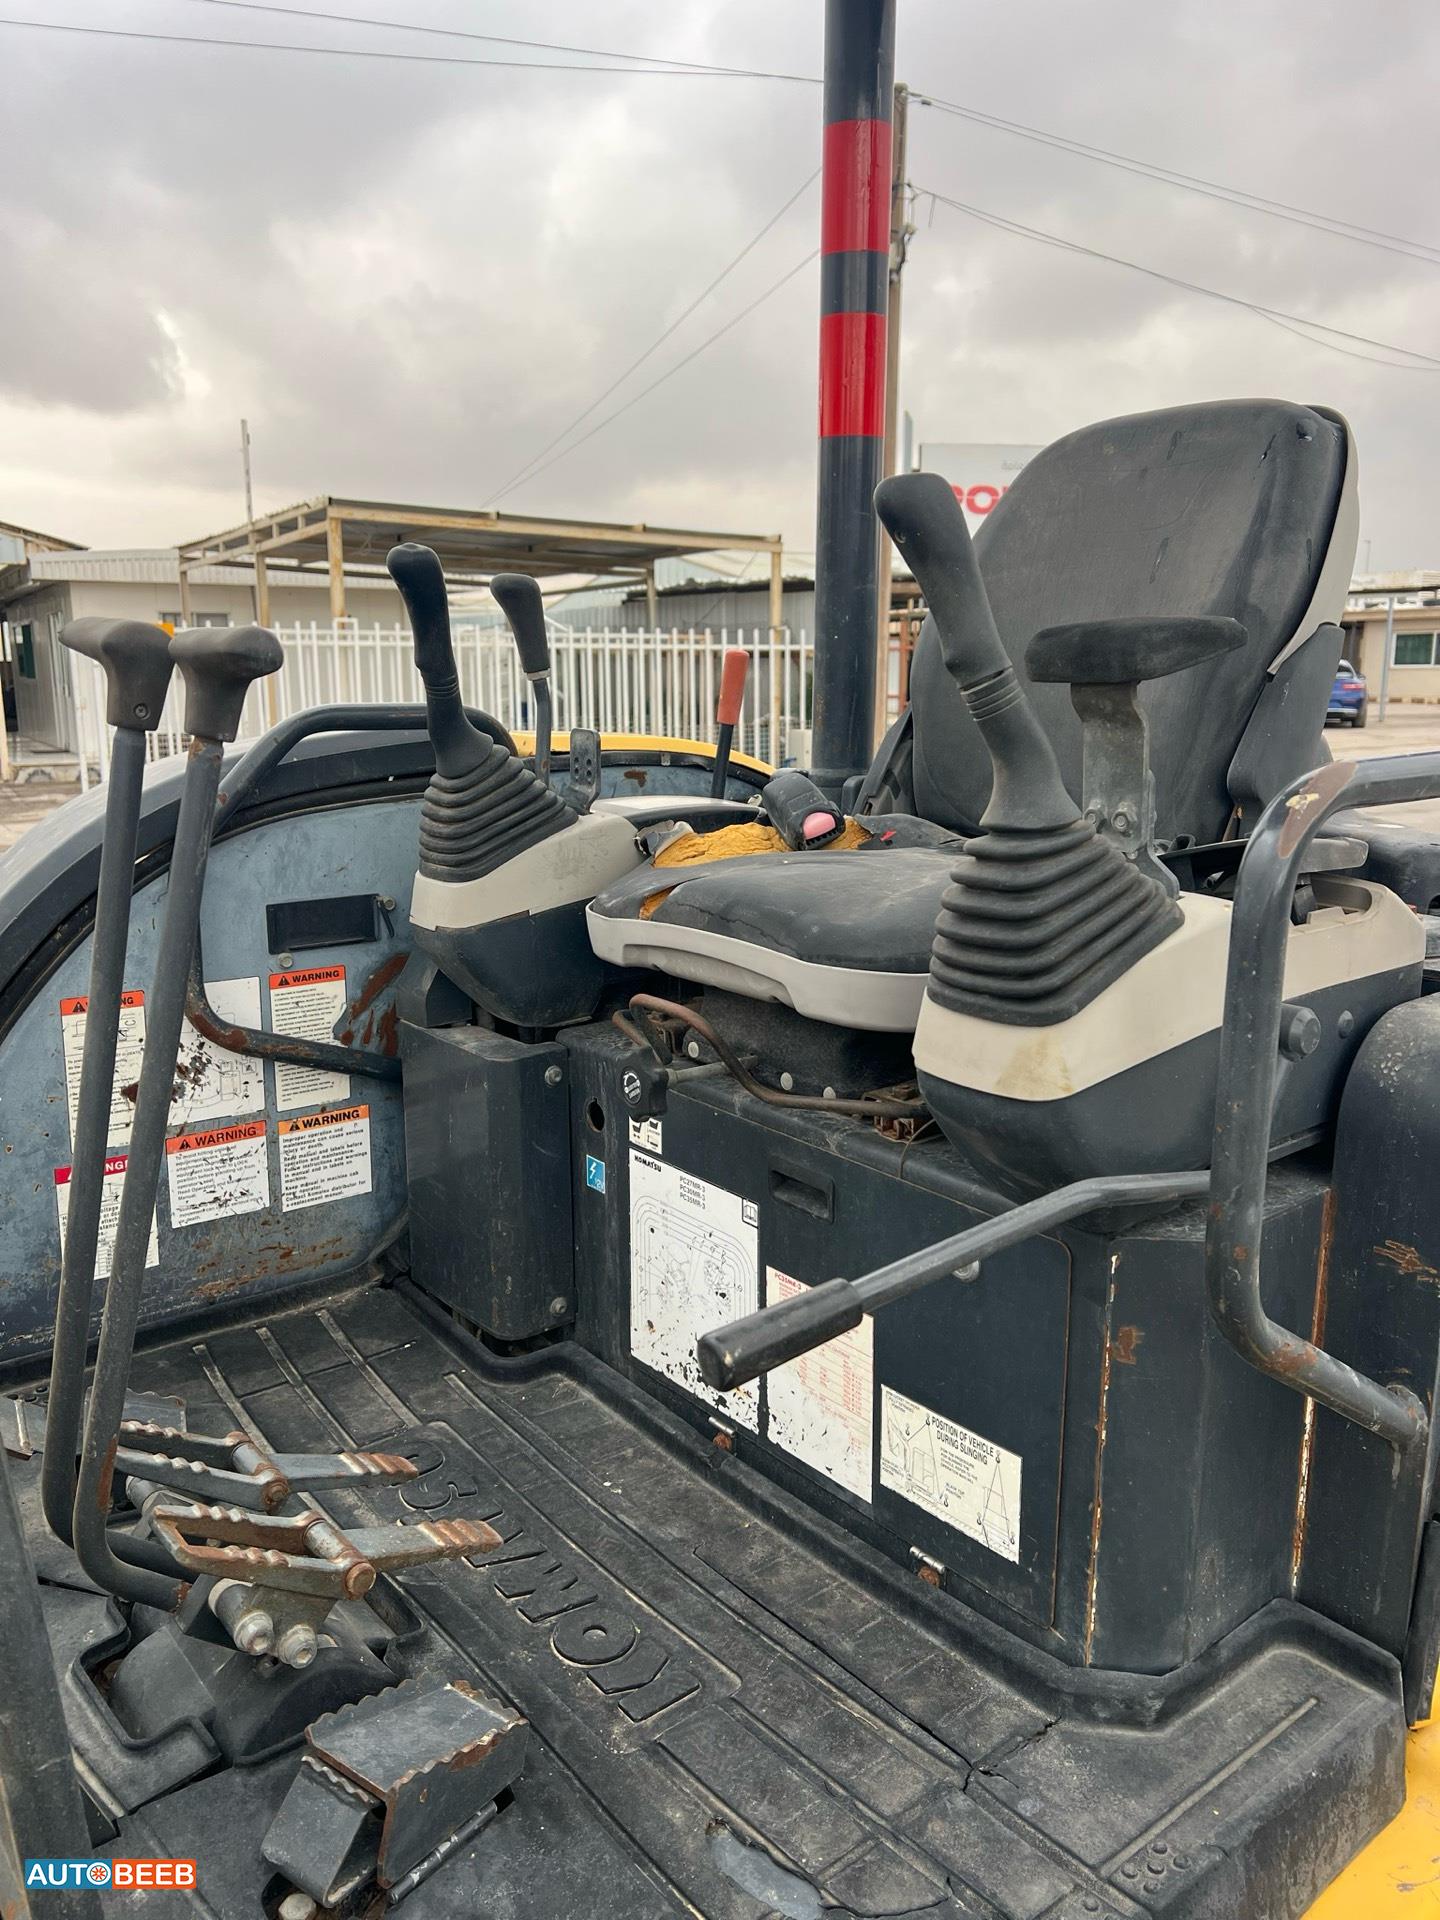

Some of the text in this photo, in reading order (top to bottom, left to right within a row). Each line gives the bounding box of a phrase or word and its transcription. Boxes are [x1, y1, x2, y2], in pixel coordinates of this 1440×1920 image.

[292, 970, 339, 983] WARNING
[302, 1109, 360, 1129] WARNING
[195, 1126, 256, 1147] WARNING
[283, 1135, 306, 1144] Improper
[284, 1158, 308, 1168] operation
[634, 1154, 661, 1173] KOMATSU
[932, 1416, 994, 1458] POSITION OF VEHICLE
[937, 1430, 988, 1466] DURING SLINGING
